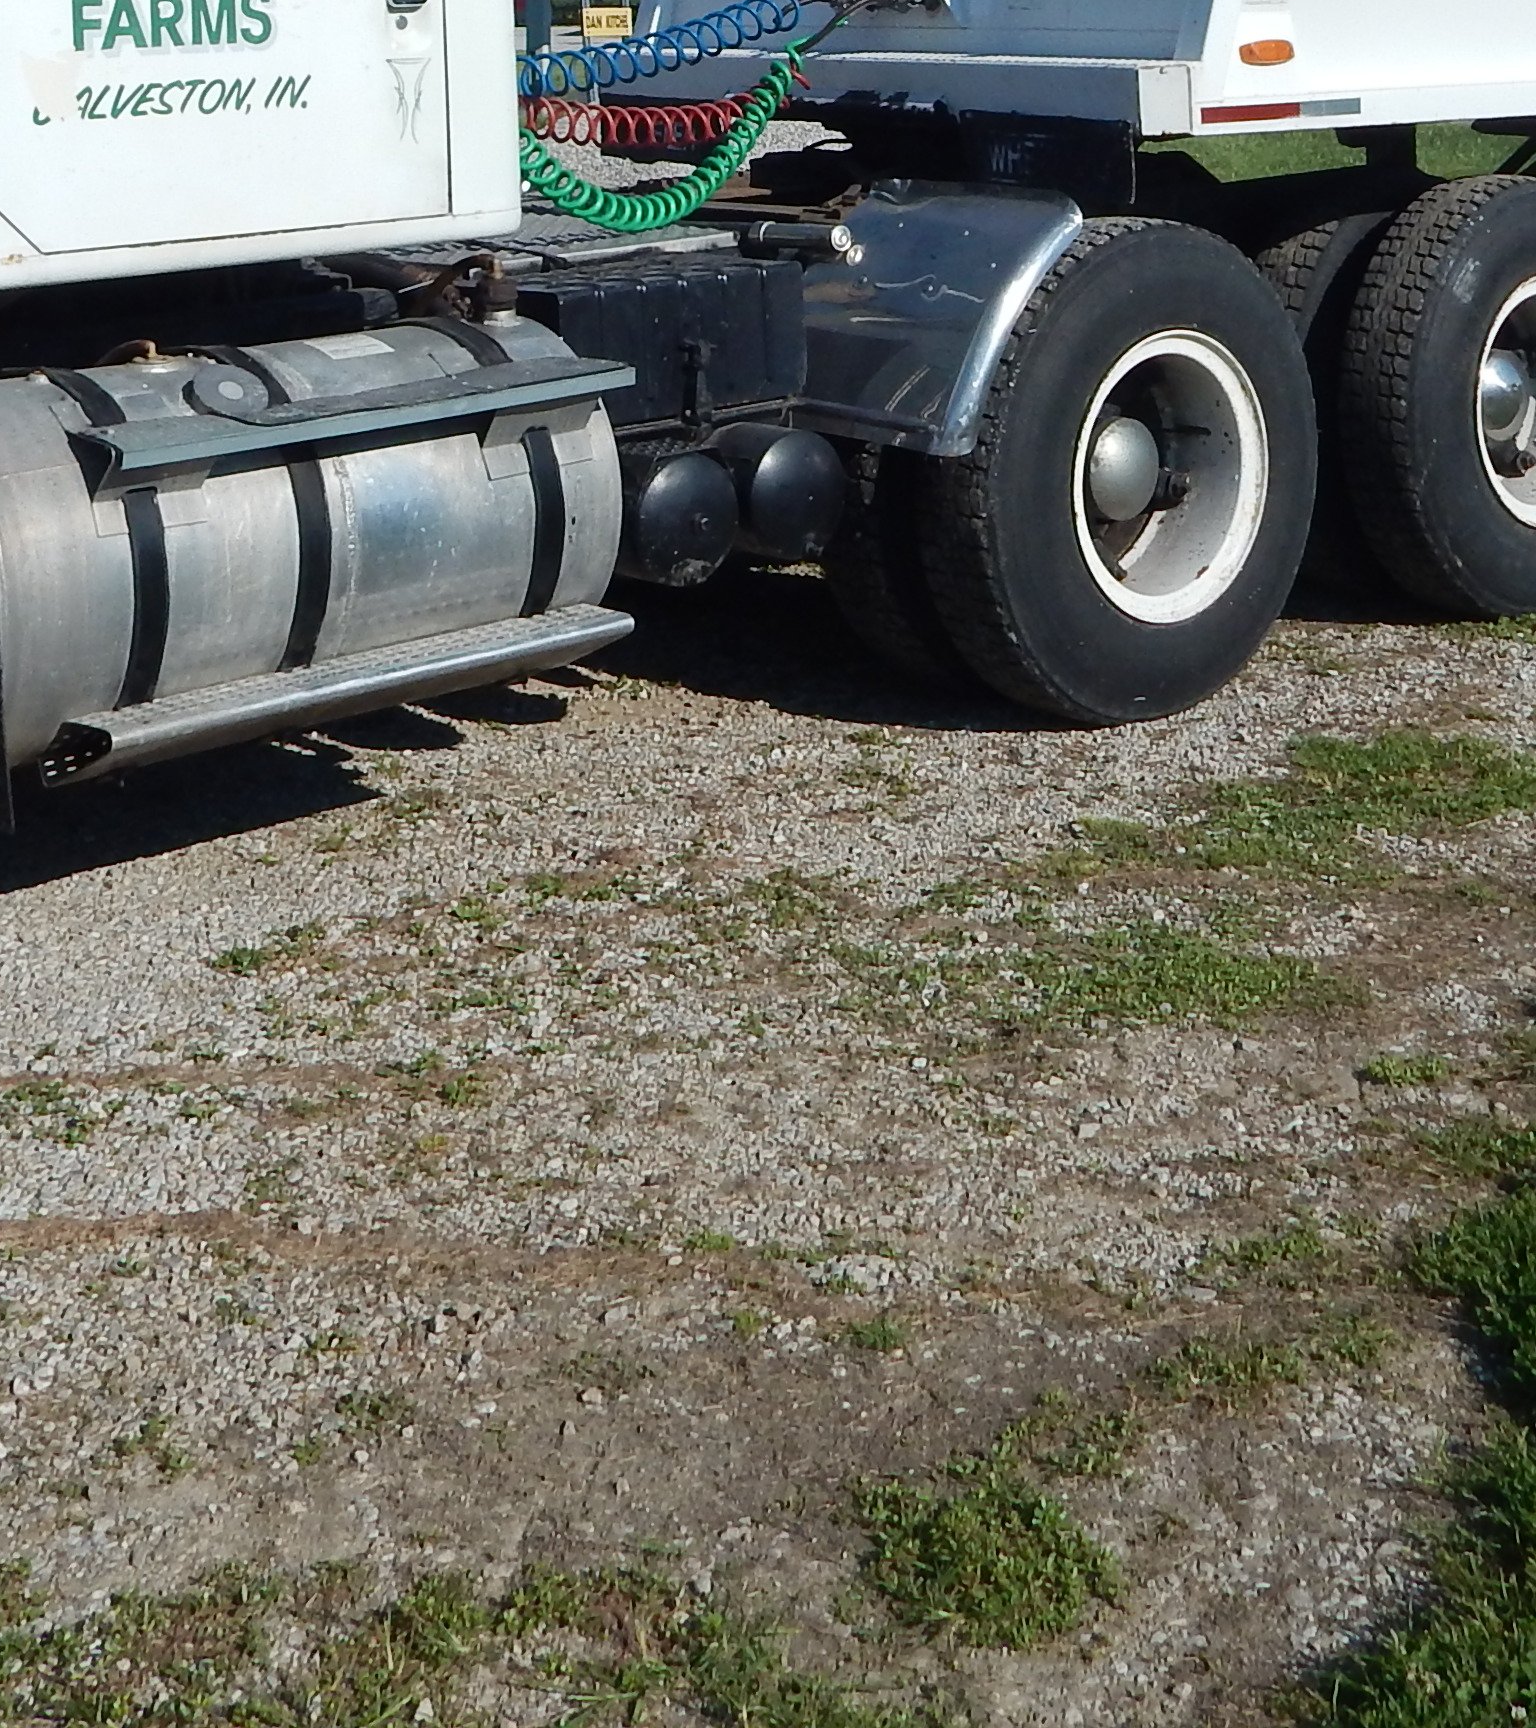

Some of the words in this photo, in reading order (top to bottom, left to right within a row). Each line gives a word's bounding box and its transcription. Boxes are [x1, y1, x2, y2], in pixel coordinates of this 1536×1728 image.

[585, 15, 603, 29] DAN
[32, 77, 256, 126] ALVESTON,
[264, 74, 312, 110] IN.
